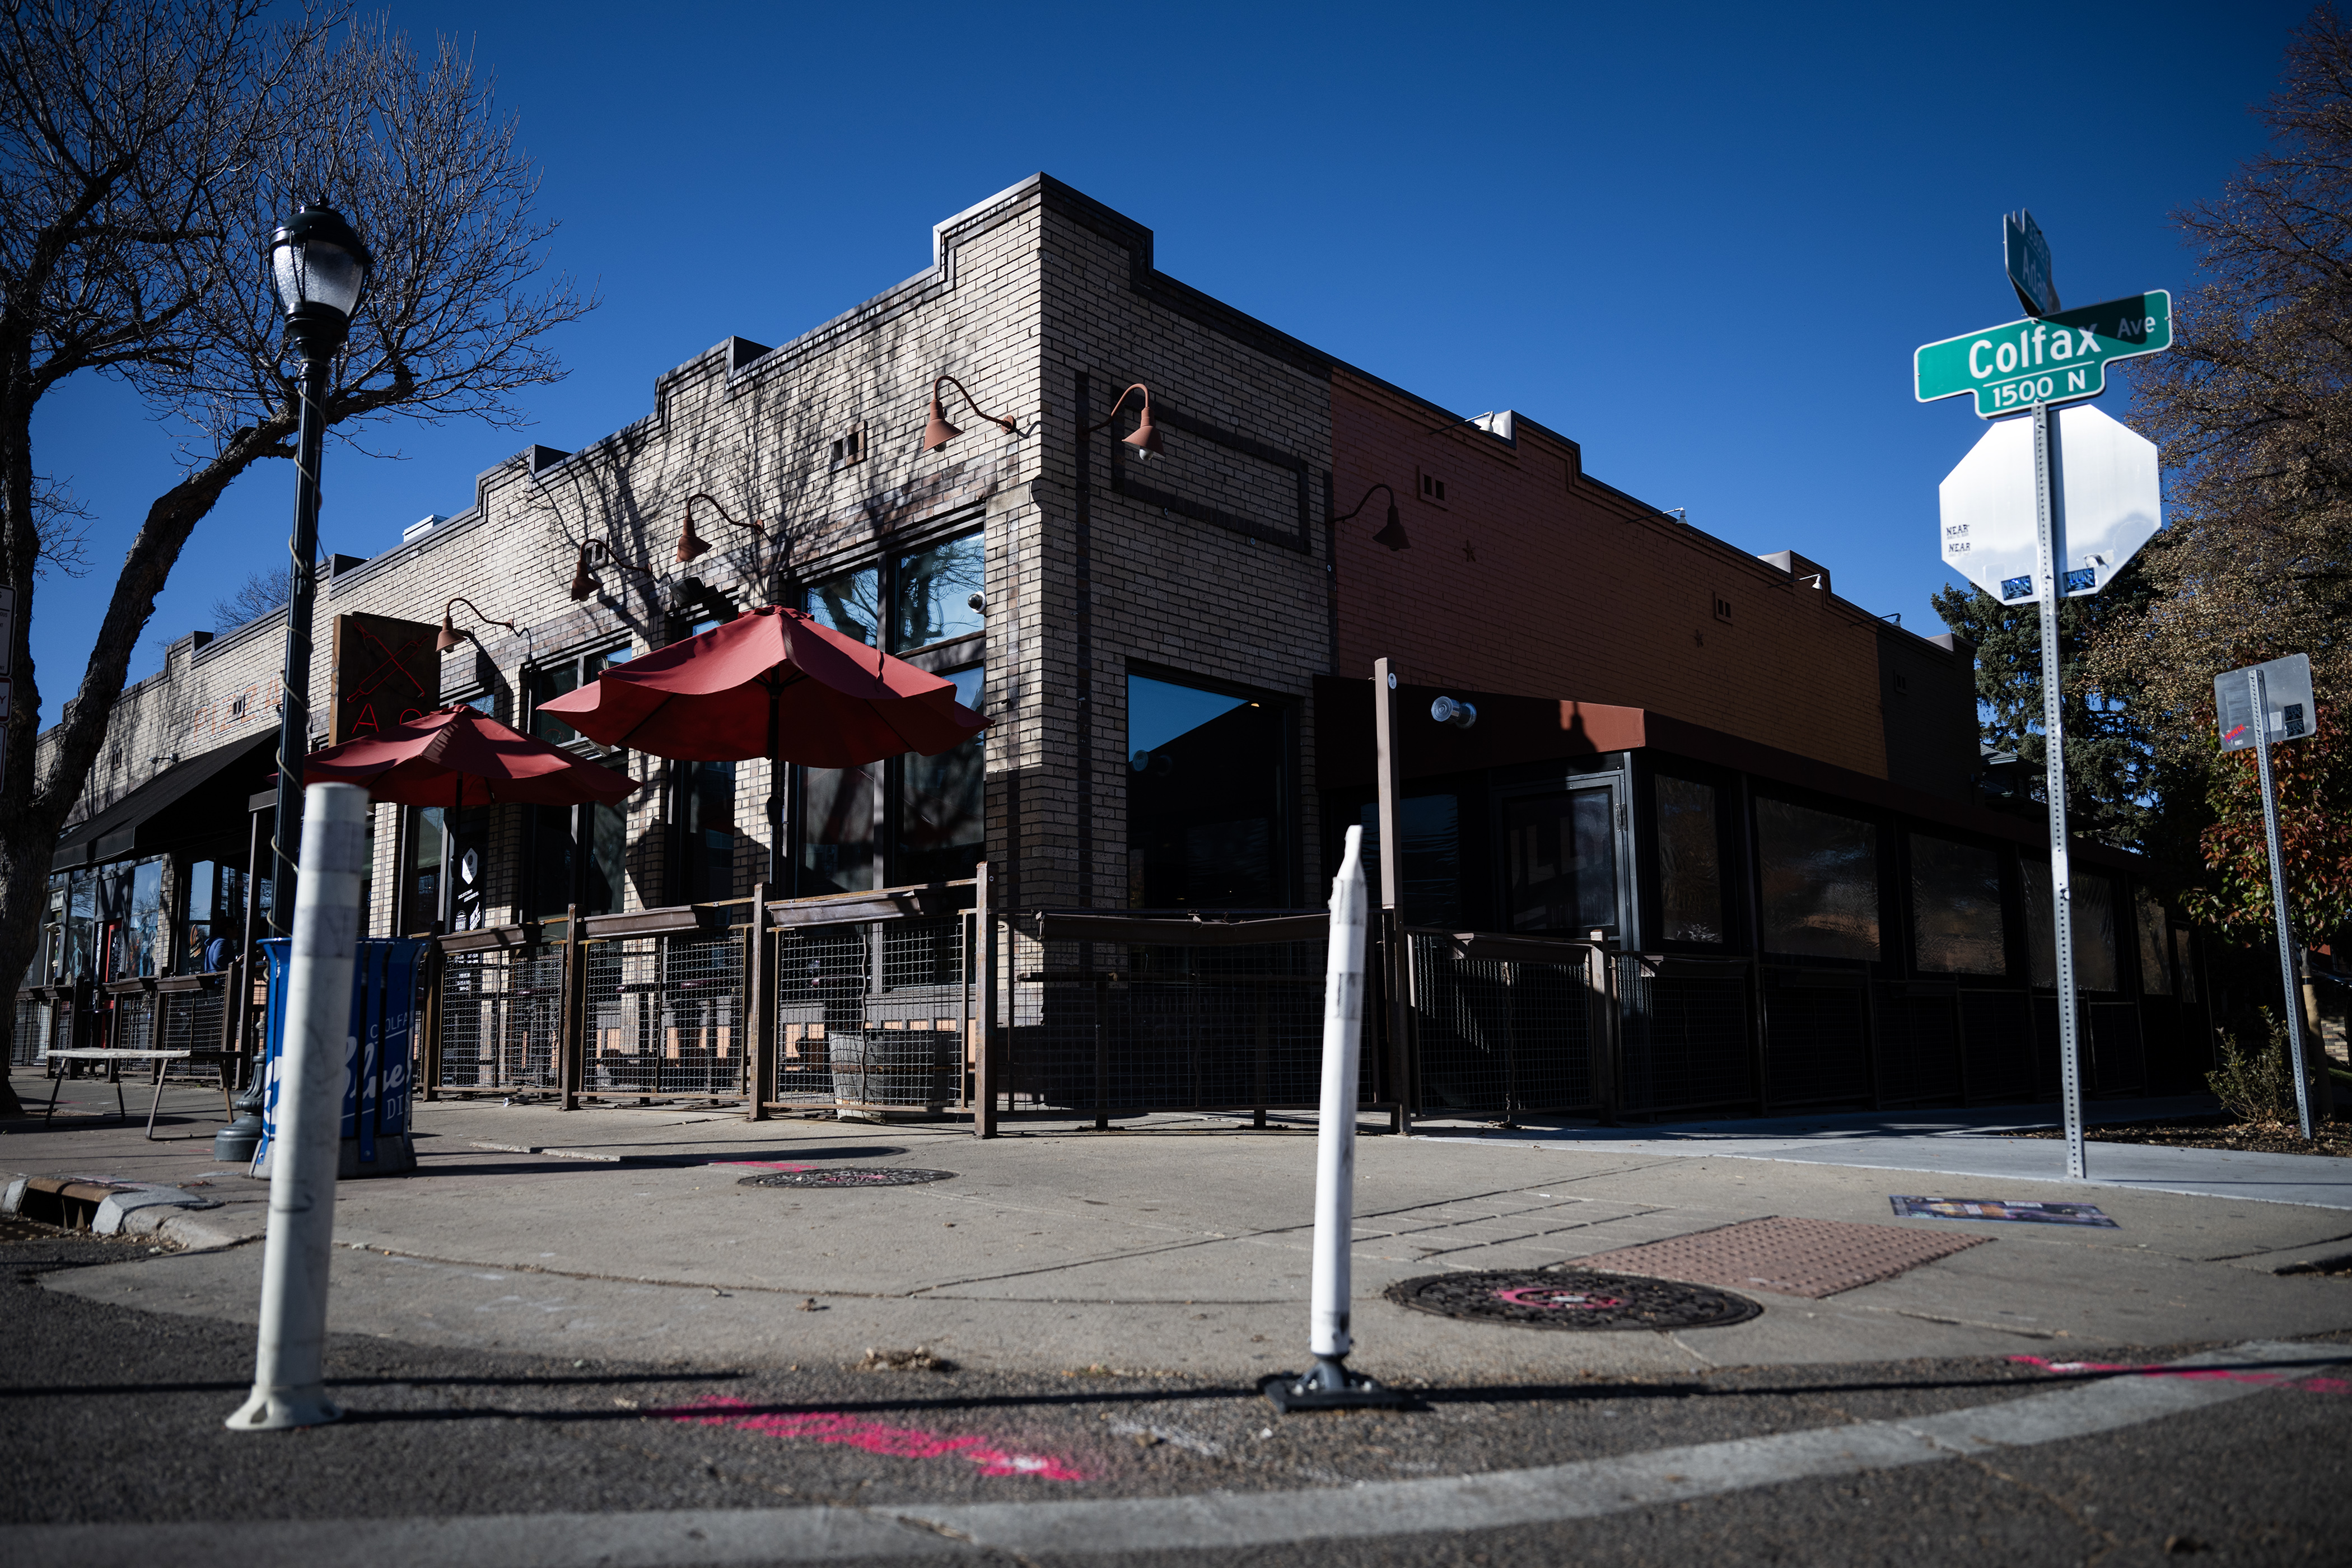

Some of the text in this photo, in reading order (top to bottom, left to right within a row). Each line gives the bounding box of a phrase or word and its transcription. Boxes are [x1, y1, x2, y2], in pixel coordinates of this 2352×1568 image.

[1968, 315, 2156, 379] Colfax Ave
[1993, 369, 2085, 408] 1500 N
[1946, 524, 1968, 536] NEAR
[1948, 543, 1971, 553] NEAR
[370, 1010, 414, 1039] COLFAX
